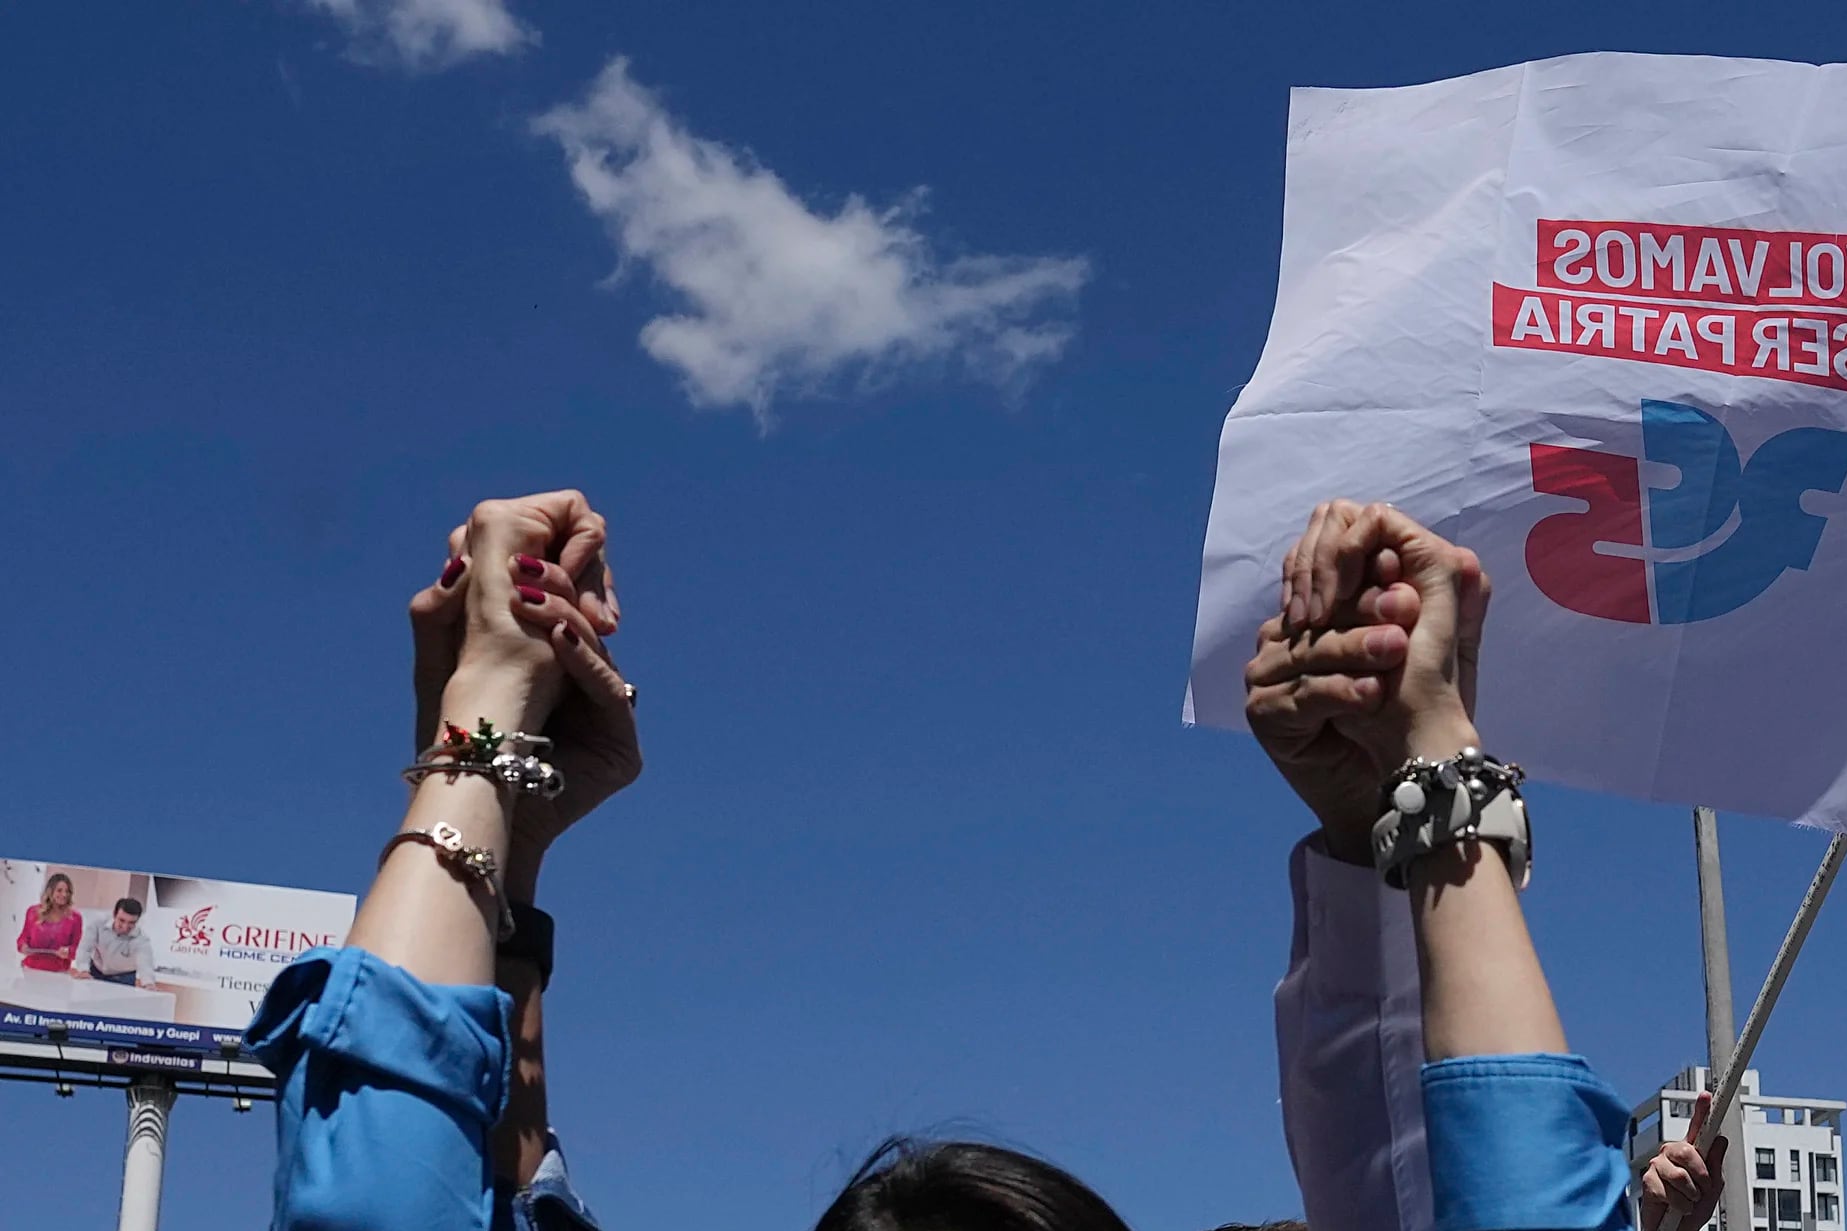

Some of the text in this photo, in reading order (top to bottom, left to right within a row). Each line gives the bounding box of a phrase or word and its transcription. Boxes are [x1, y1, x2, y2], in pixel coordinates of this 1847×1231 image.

[220, 949, 265, 961] HOME
[4, 1013, 22, 1025] Av.
[25, 1013, 36, 1026] El
[65, 1019, 94, 1031] entre
[96, 1021, 155, 1037] Amazonas
[156, 1028, 164, 1039] y
